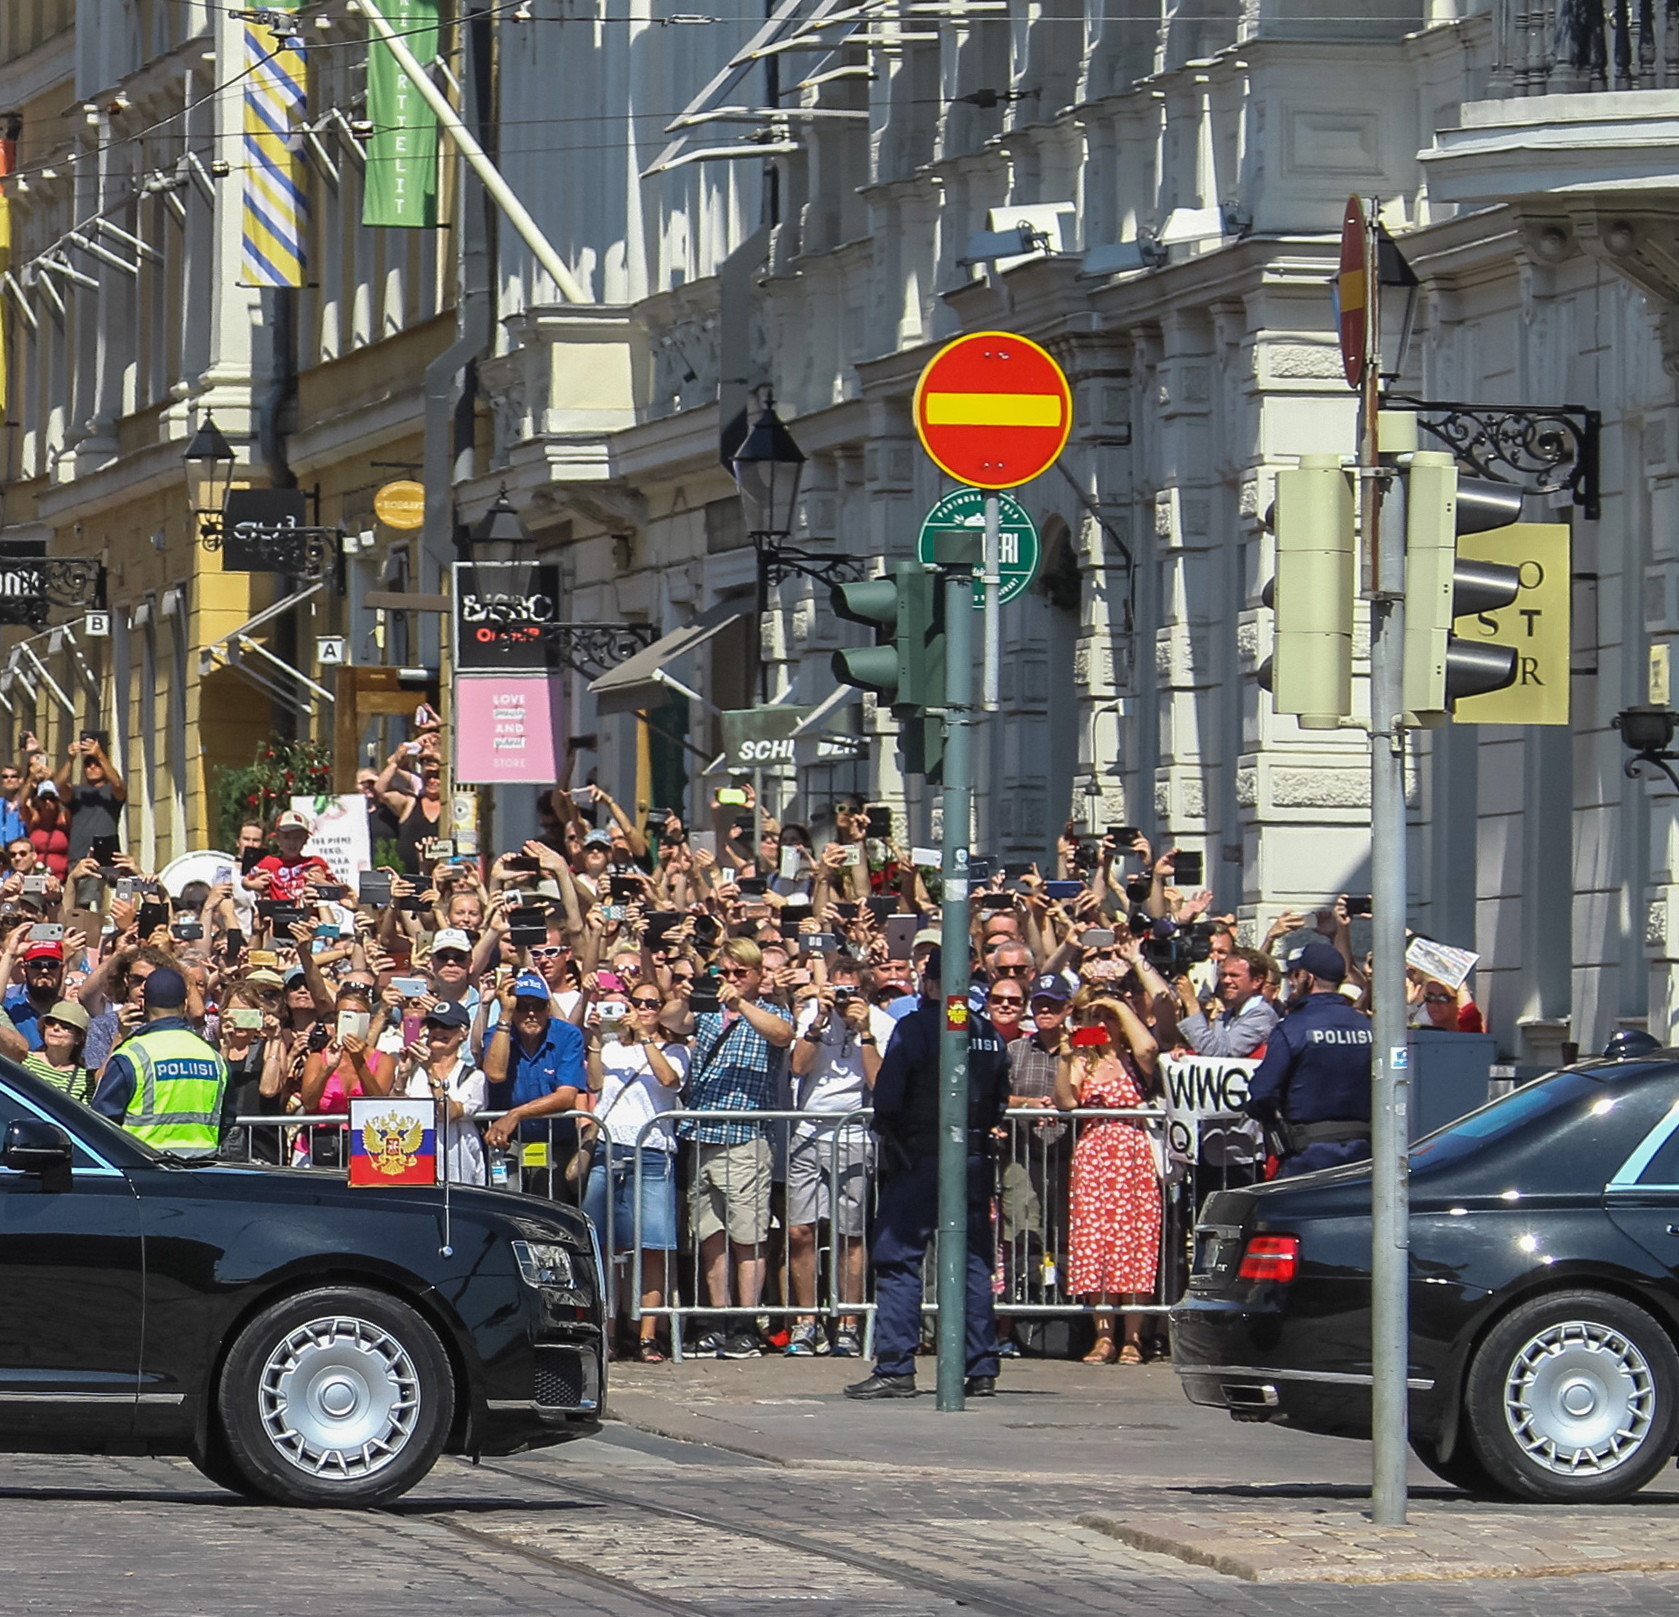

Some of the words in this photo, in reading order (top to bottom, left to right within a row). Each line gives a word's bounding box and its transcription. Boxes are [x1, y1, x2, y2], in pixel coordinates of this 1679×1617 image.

[92, 616, 104, 631] B
[322, 643, 338, 658] A
[492, 694, 526, 705] LOVE
[495, 723, 525, 733] AND
[493, 758, 526, 768] STORE
[1312, 1029, 1373, 1044] POLIISI
[156, 1062, 213, 1077] POLIISI
[1166, 1063, 1251, 1113] WWG
[1169, 1120, 1195, 1160] Q
